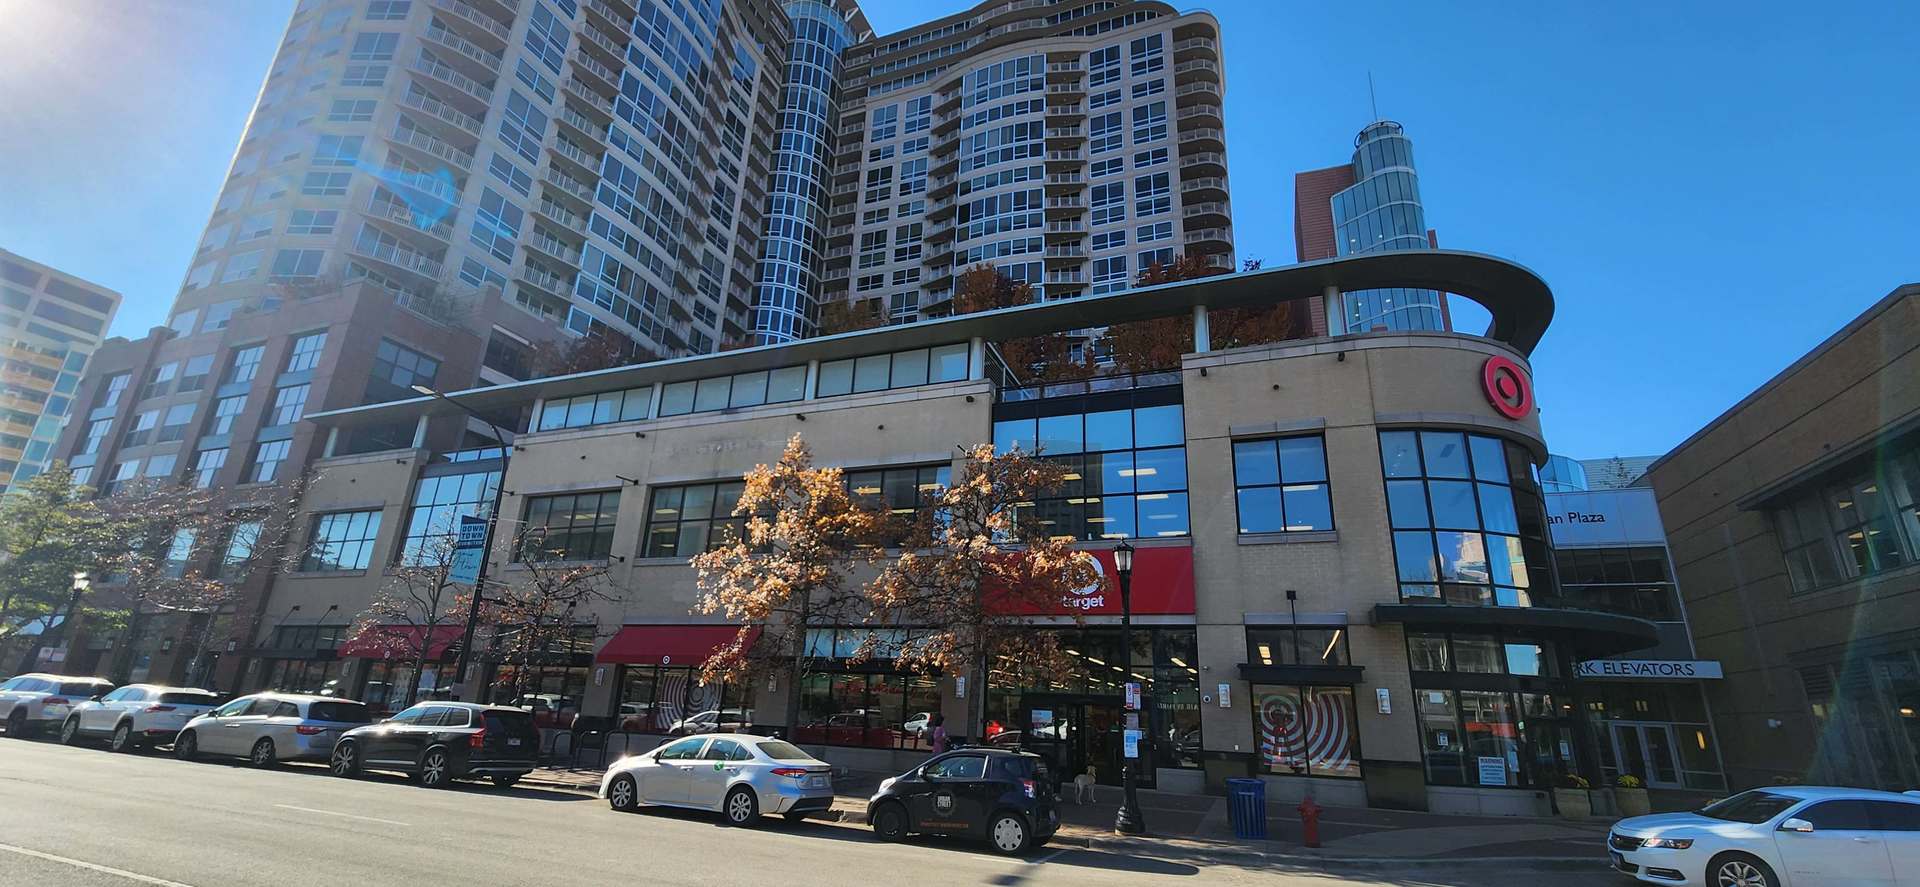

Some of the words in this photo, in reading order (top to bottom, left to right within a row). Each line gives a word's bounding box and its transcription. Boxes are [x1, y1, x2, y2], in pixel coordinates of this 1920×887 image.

[1567, 511, 1606, 523] Plaza
[461, 532, 484, 540] TOWN
[1062, 595, 1105, 610] target
[1603, 662, 1695, 676] ELEVATORS
